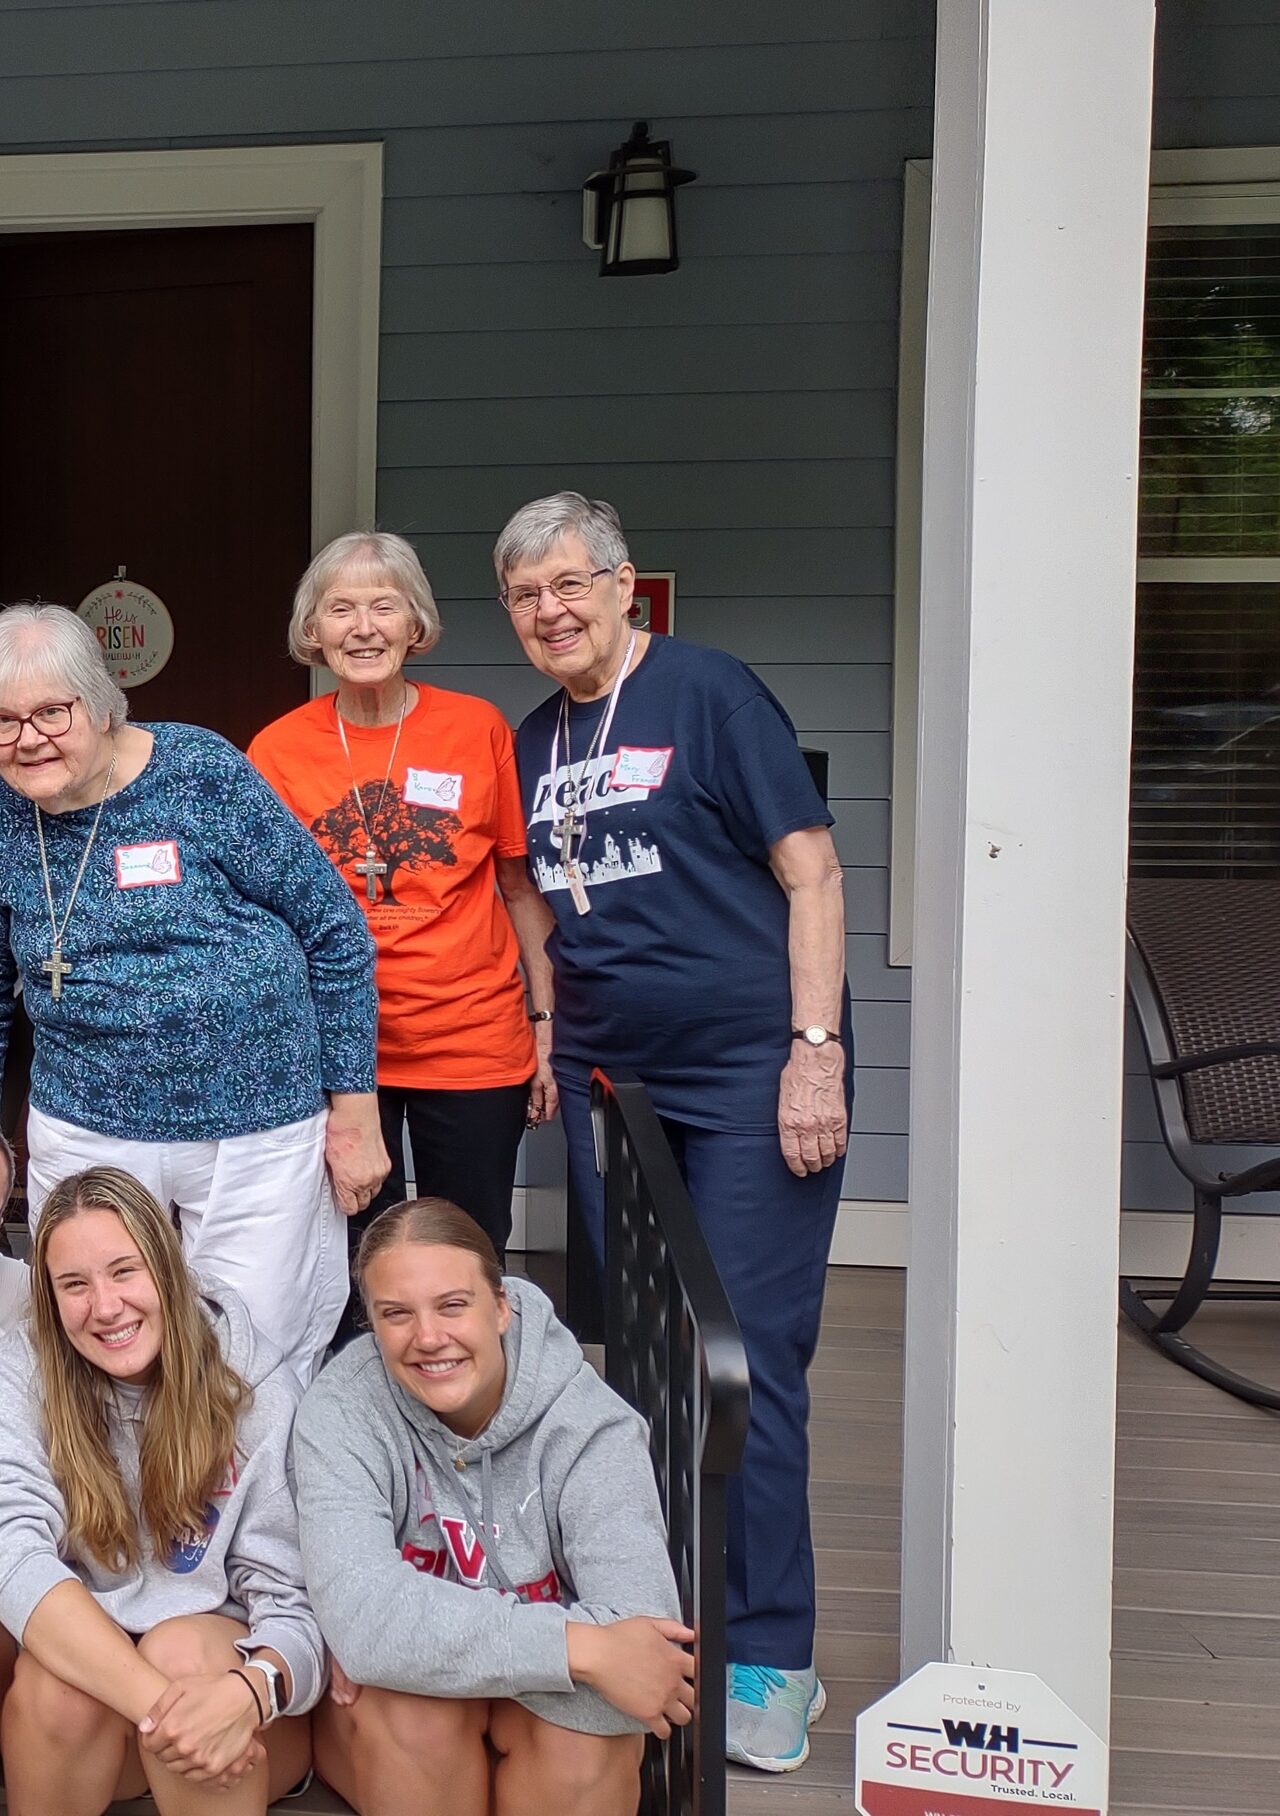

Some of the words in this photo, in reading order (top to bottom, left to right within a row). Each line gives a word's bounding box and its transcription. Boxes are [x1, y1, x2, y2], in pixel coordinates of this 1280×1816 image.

[104, 606, 123, 625] He
[123, 611, 138, 624] is
[96, 625, 145, 650] RISEN
[943, 1694, 1002, 1711] Protected
[1006, 1700, 1021, 1712] by
[942, 1719, 1019, 1753] WH
[886, 1742, 1075, 1788] SECURITY
[991, 1784, 1038, 1798] Trusted.
[1042, 1790, 1076, 1802] Local.
